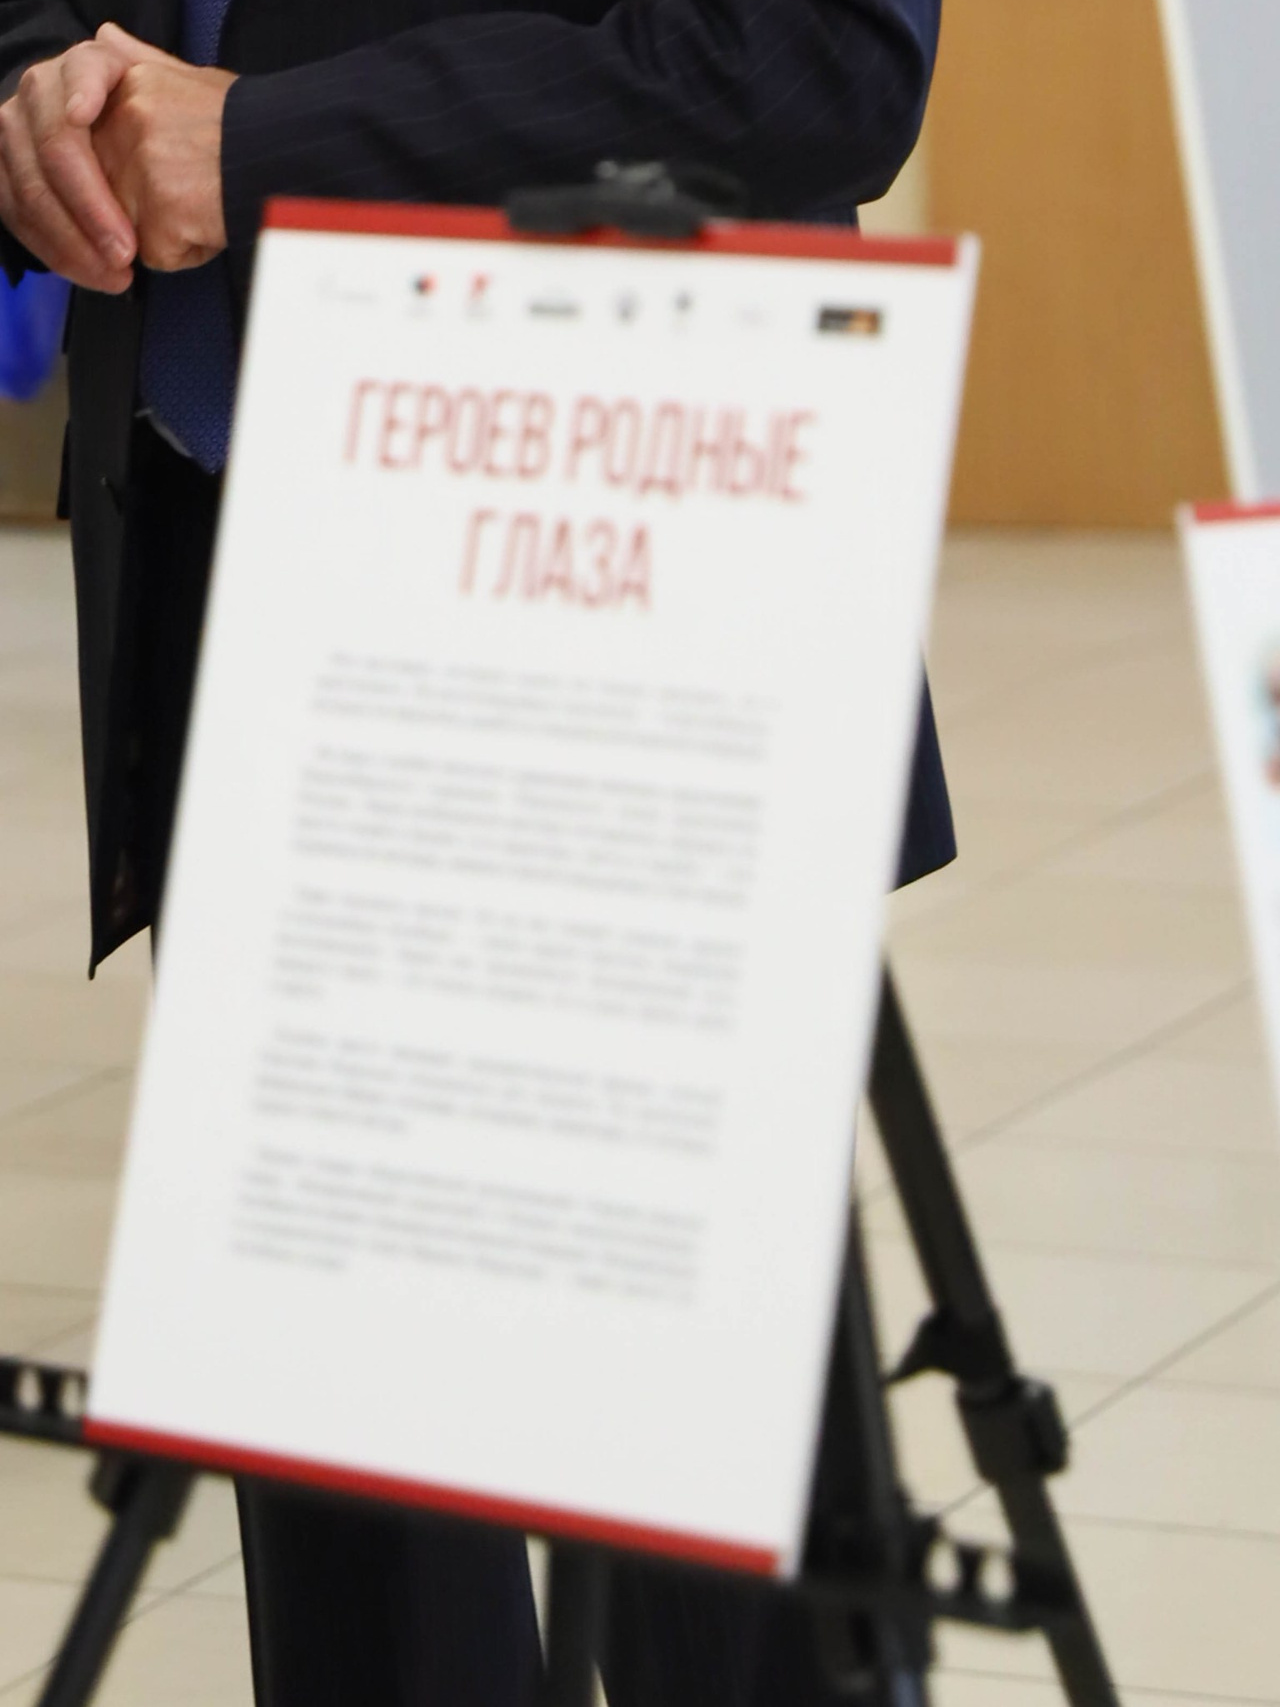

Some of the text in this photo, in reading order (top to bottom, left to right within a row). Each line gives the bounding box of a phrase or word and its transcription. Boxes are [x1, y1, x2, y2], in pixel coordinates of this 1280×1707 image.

[343, 379, 815, 502] ГЕРОЕВ РОДНЫЕ
[460, 507, 654, 609] ГЛАЗА
